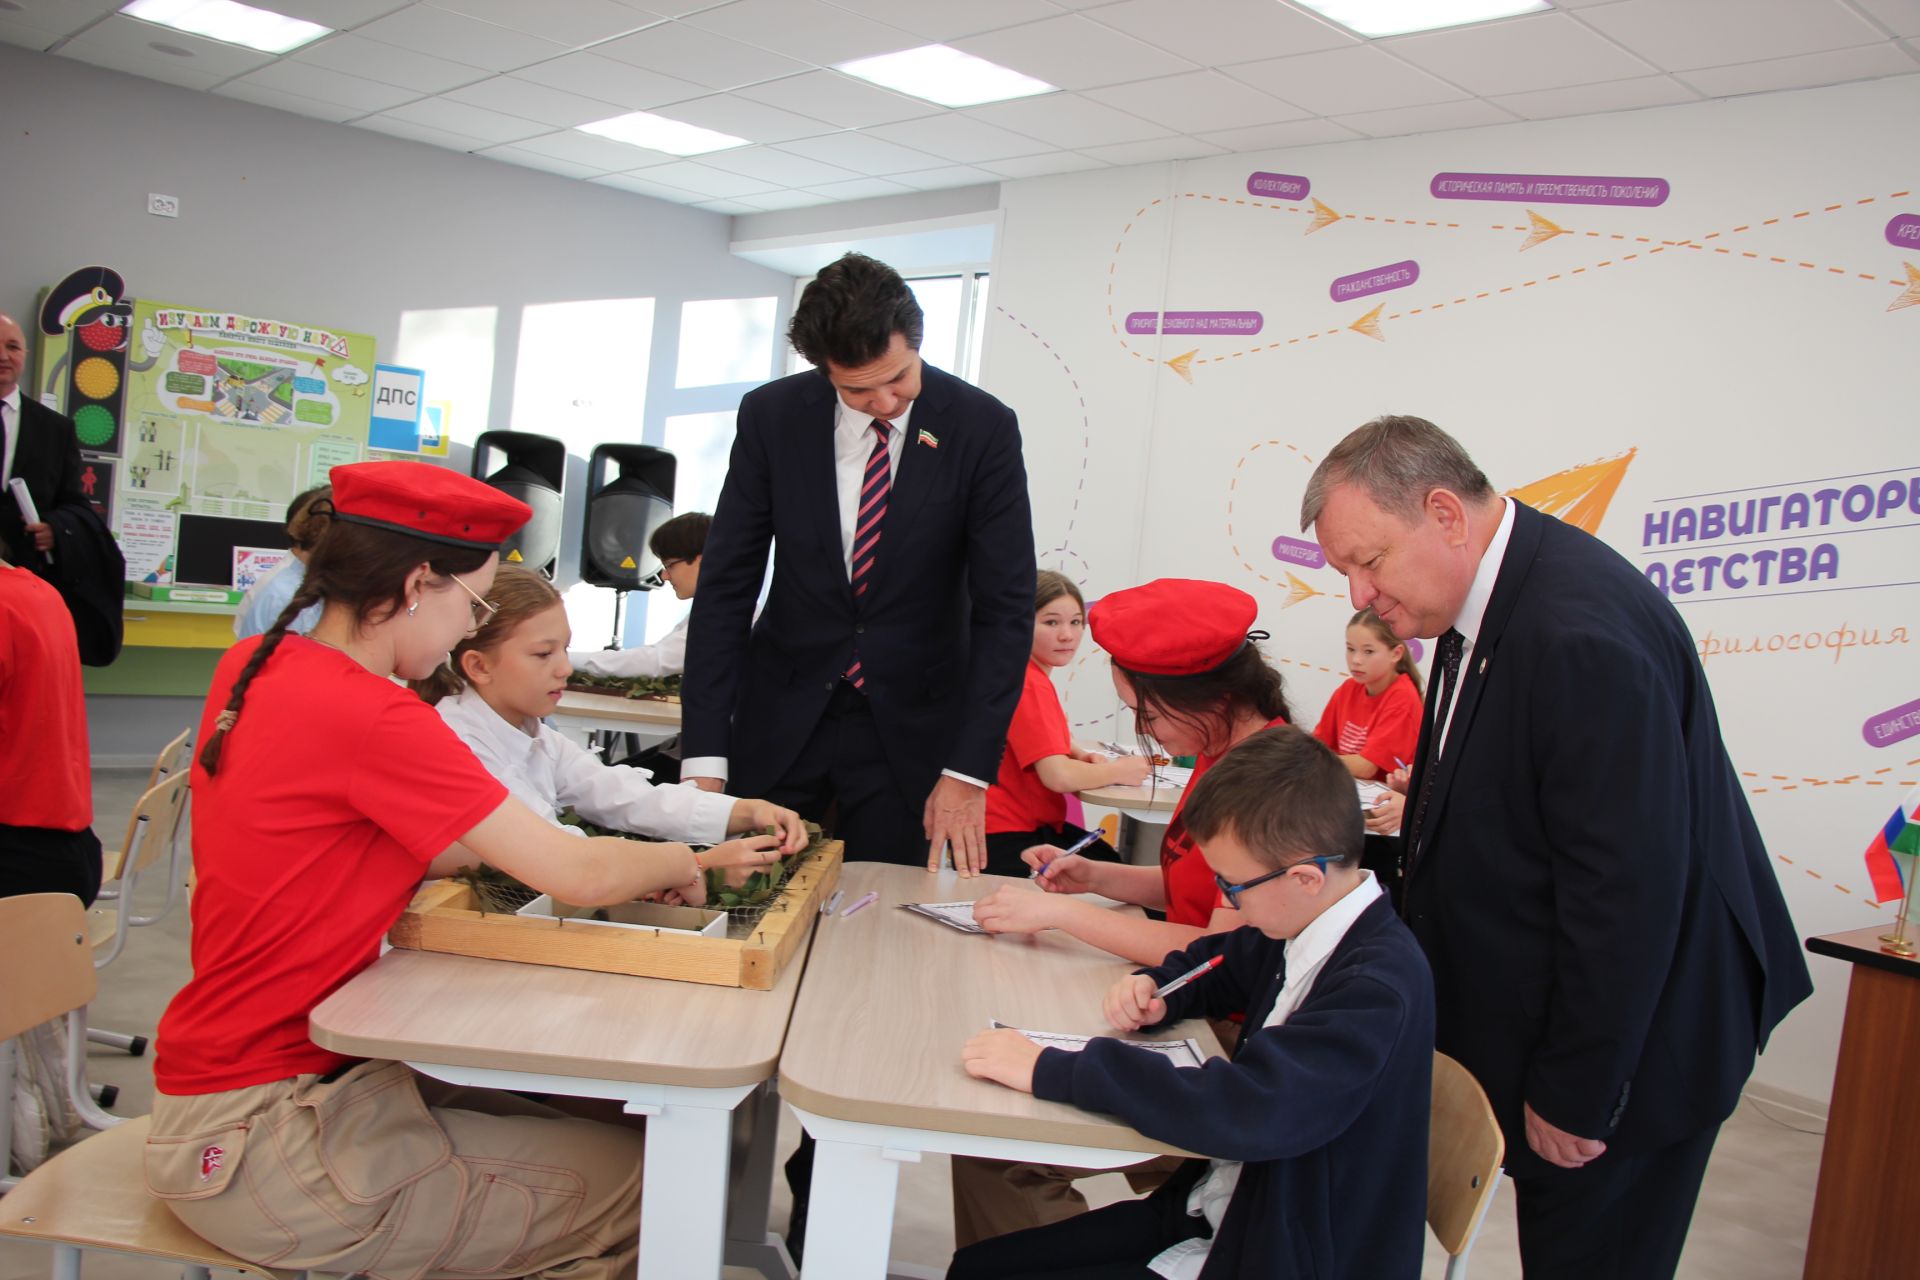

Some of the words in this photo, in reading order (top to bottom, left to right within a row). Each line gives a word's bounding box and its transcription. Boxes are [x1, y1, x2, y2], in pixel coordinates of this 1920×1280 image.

[1438, 180, 1493, 193] ИСТОРИЧЕСКАЯ
[1495, 181, 1524, 195] ПАМЯТЬ
[1526, 183, 1534, 195] И
[1535, 183, 1608, 198] ПРЕЕМСТВЕННОСТЬ
[1609, 184, 1659, 199] ПОКОЛЕНИЙ
[376, 386, 417, 406] ДПС
